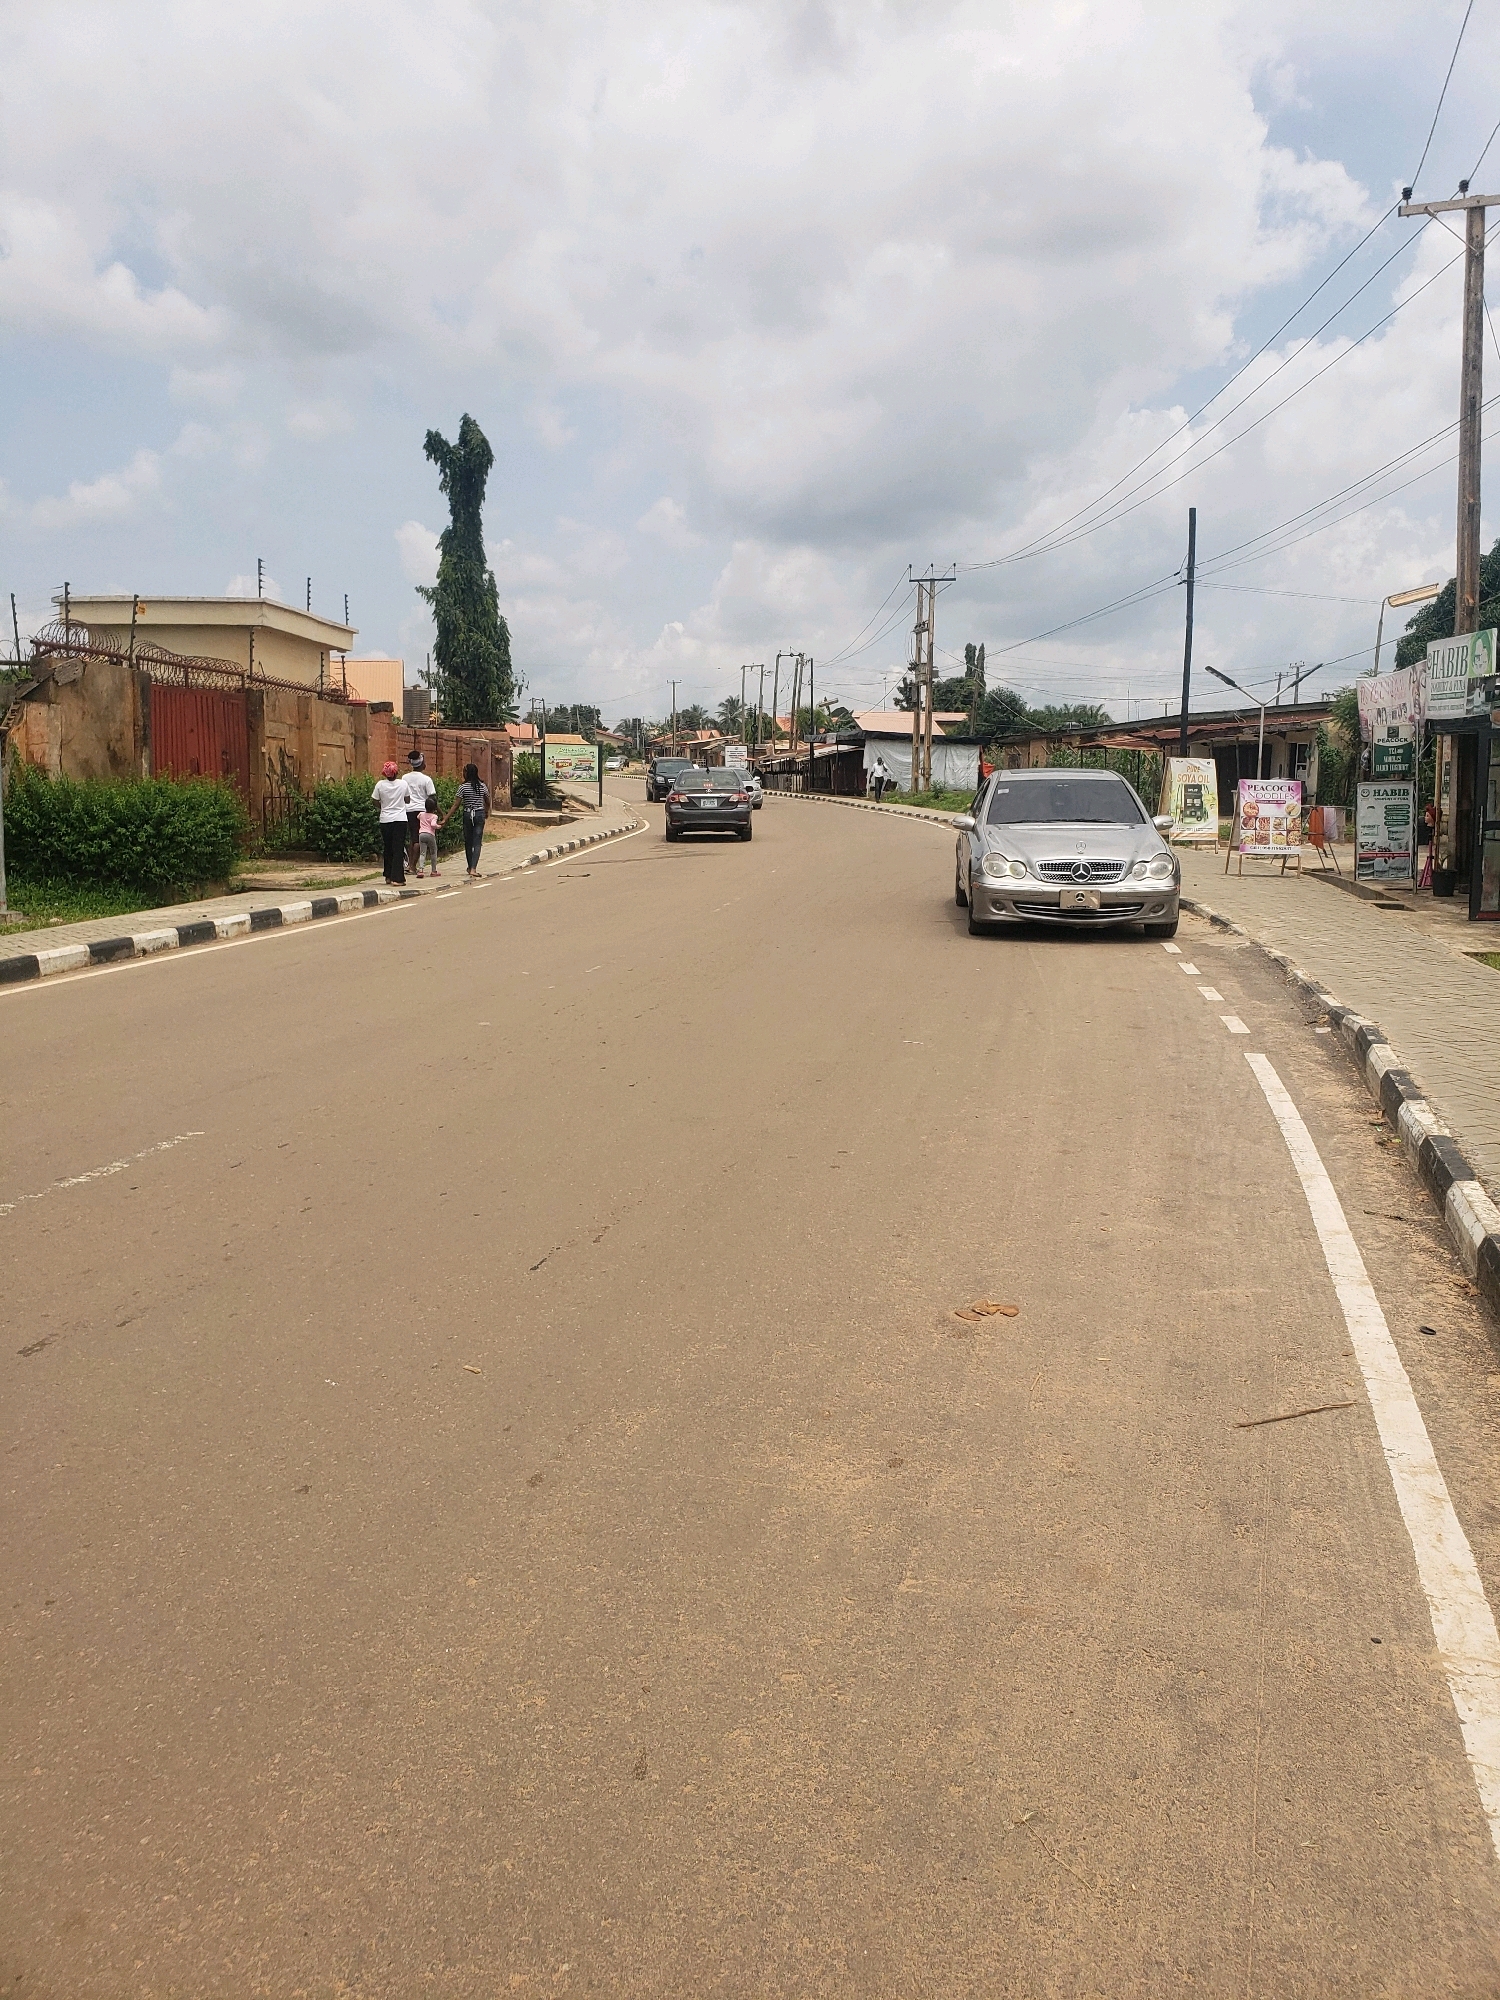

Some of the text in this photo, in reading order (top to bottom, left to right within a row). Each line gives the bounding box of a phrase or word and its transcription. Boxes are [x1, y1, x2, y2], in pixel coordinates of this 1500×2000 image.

[1431, 645, 1468, 680] HABIB
[1177, 774, 1210, 783] SOYA OIL
[1249, 792, 1295, 800] NOODLES
[1373, 789, 1409, 797] HABIB
